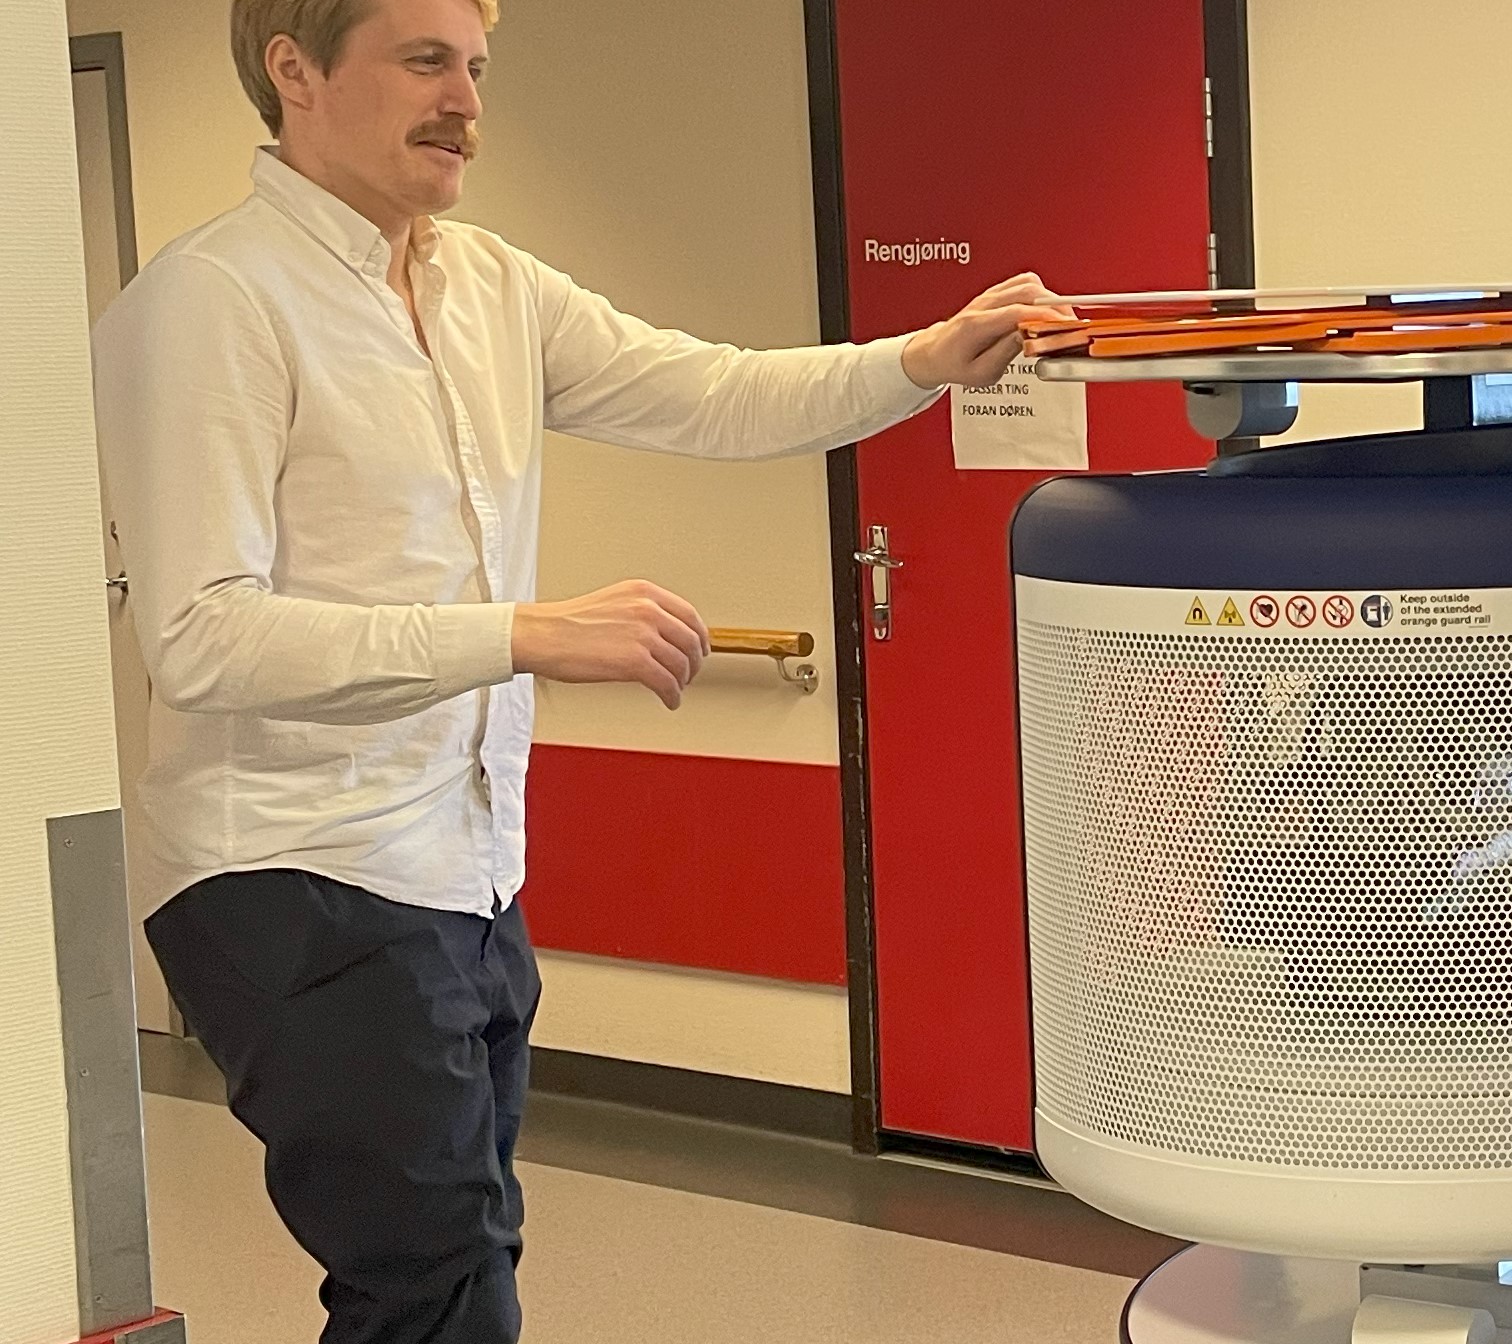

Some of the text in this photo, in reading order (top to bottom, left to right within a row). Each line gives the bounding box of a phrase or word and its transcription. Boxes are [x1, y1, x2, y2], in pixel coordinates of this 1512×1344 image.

[864, 238, 970, 265] Rengjøring
[1018, 363, 1036, 375] IKK
[1005, 384, 1029, 395] TING
[962, 404, 997, 416] FORAN
[1400, 594, 1470, 604] Keep outside
[1400, 605, 1482, 615] of the extended
[1400, 615, 1490, 627] orange guard rail
